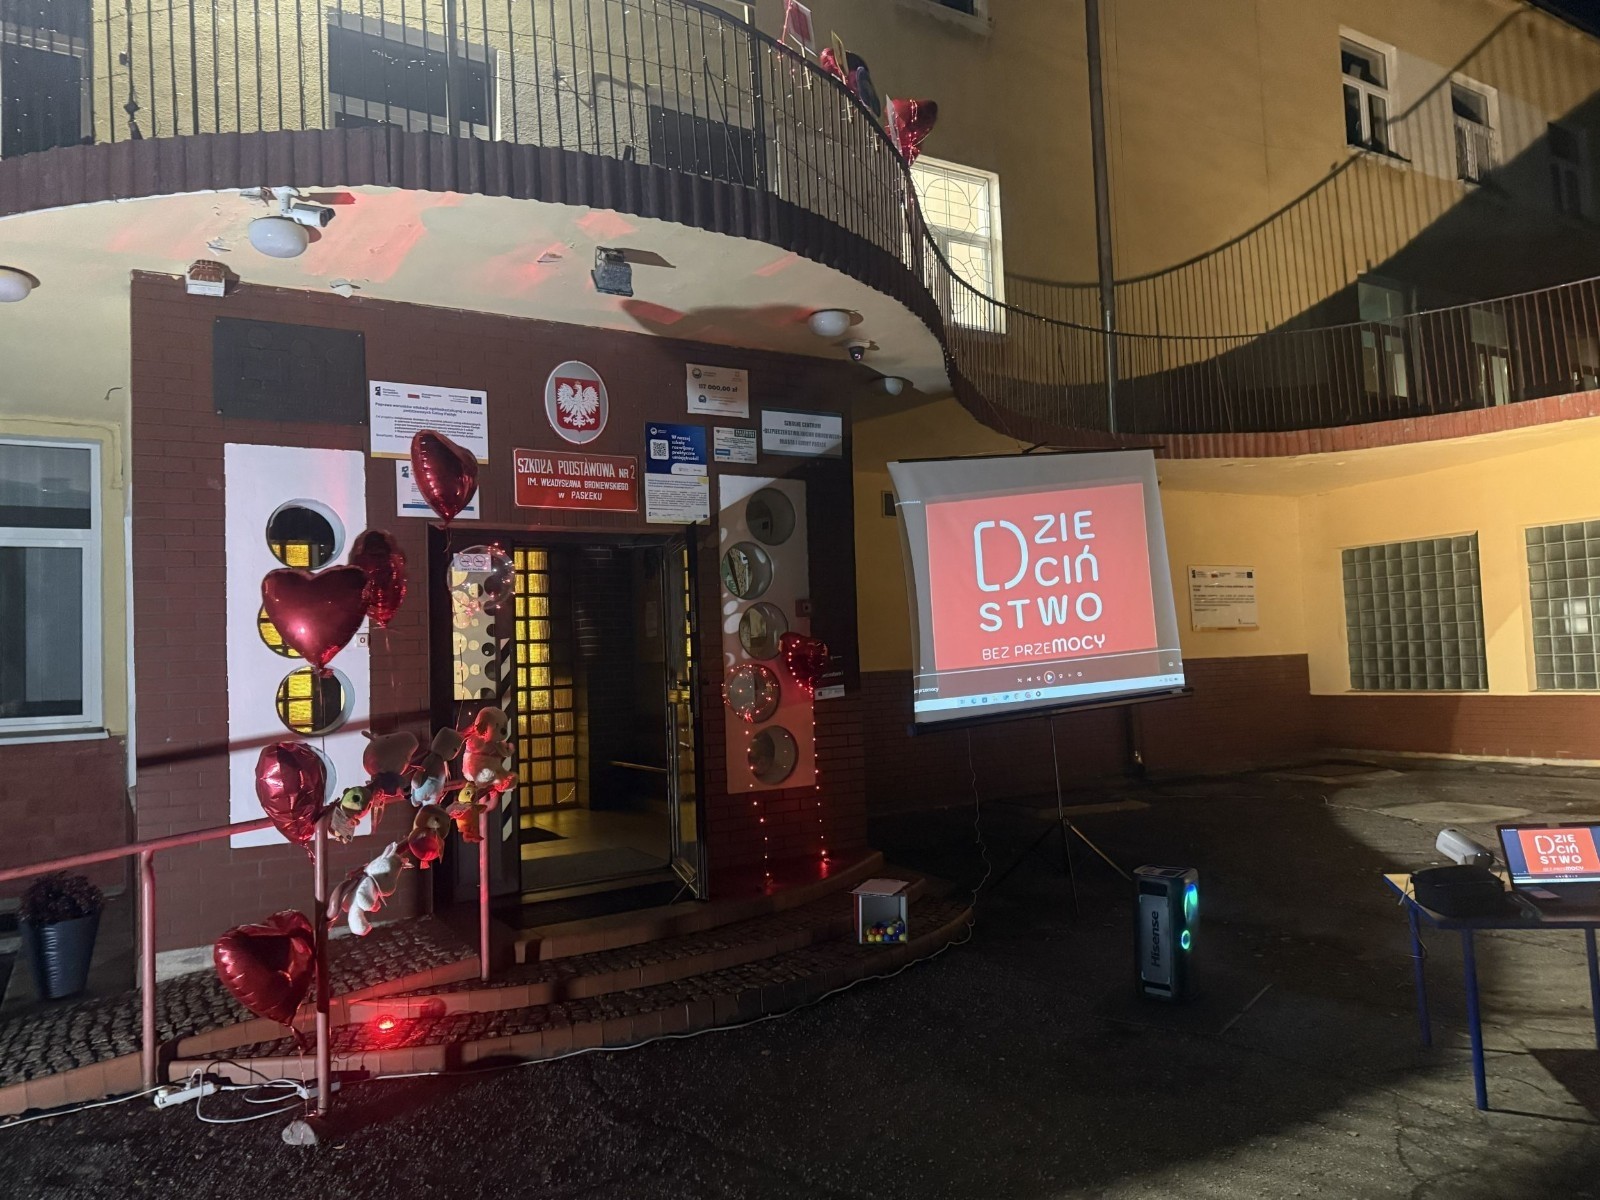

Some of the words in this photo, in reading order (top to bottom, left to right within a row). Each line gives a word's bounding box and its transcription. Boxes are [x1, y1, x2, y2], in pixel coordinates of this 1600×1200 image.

[518, 458, 553, 474] SZKOŁA
[558, 460, 615, 477] PODSTAWOWA
[618, 468, 629, 478] NR
[630, 465, 635, 479] 2
[527, 477, 538, 486] IM.
[541, 478, 581, 488] WŁADYSŁAWA
[584, 481, 629, 491] BRONIEWSKIEGO
[979, 592, 1103, 632] STWO
[982, 646, 1010, 661] BEZ
[1014, 633, 1106, 657] PRZEMOCY
[1540, 855, 1582, 865] STWO
[1151, 910, 1160, 967] Hisense
